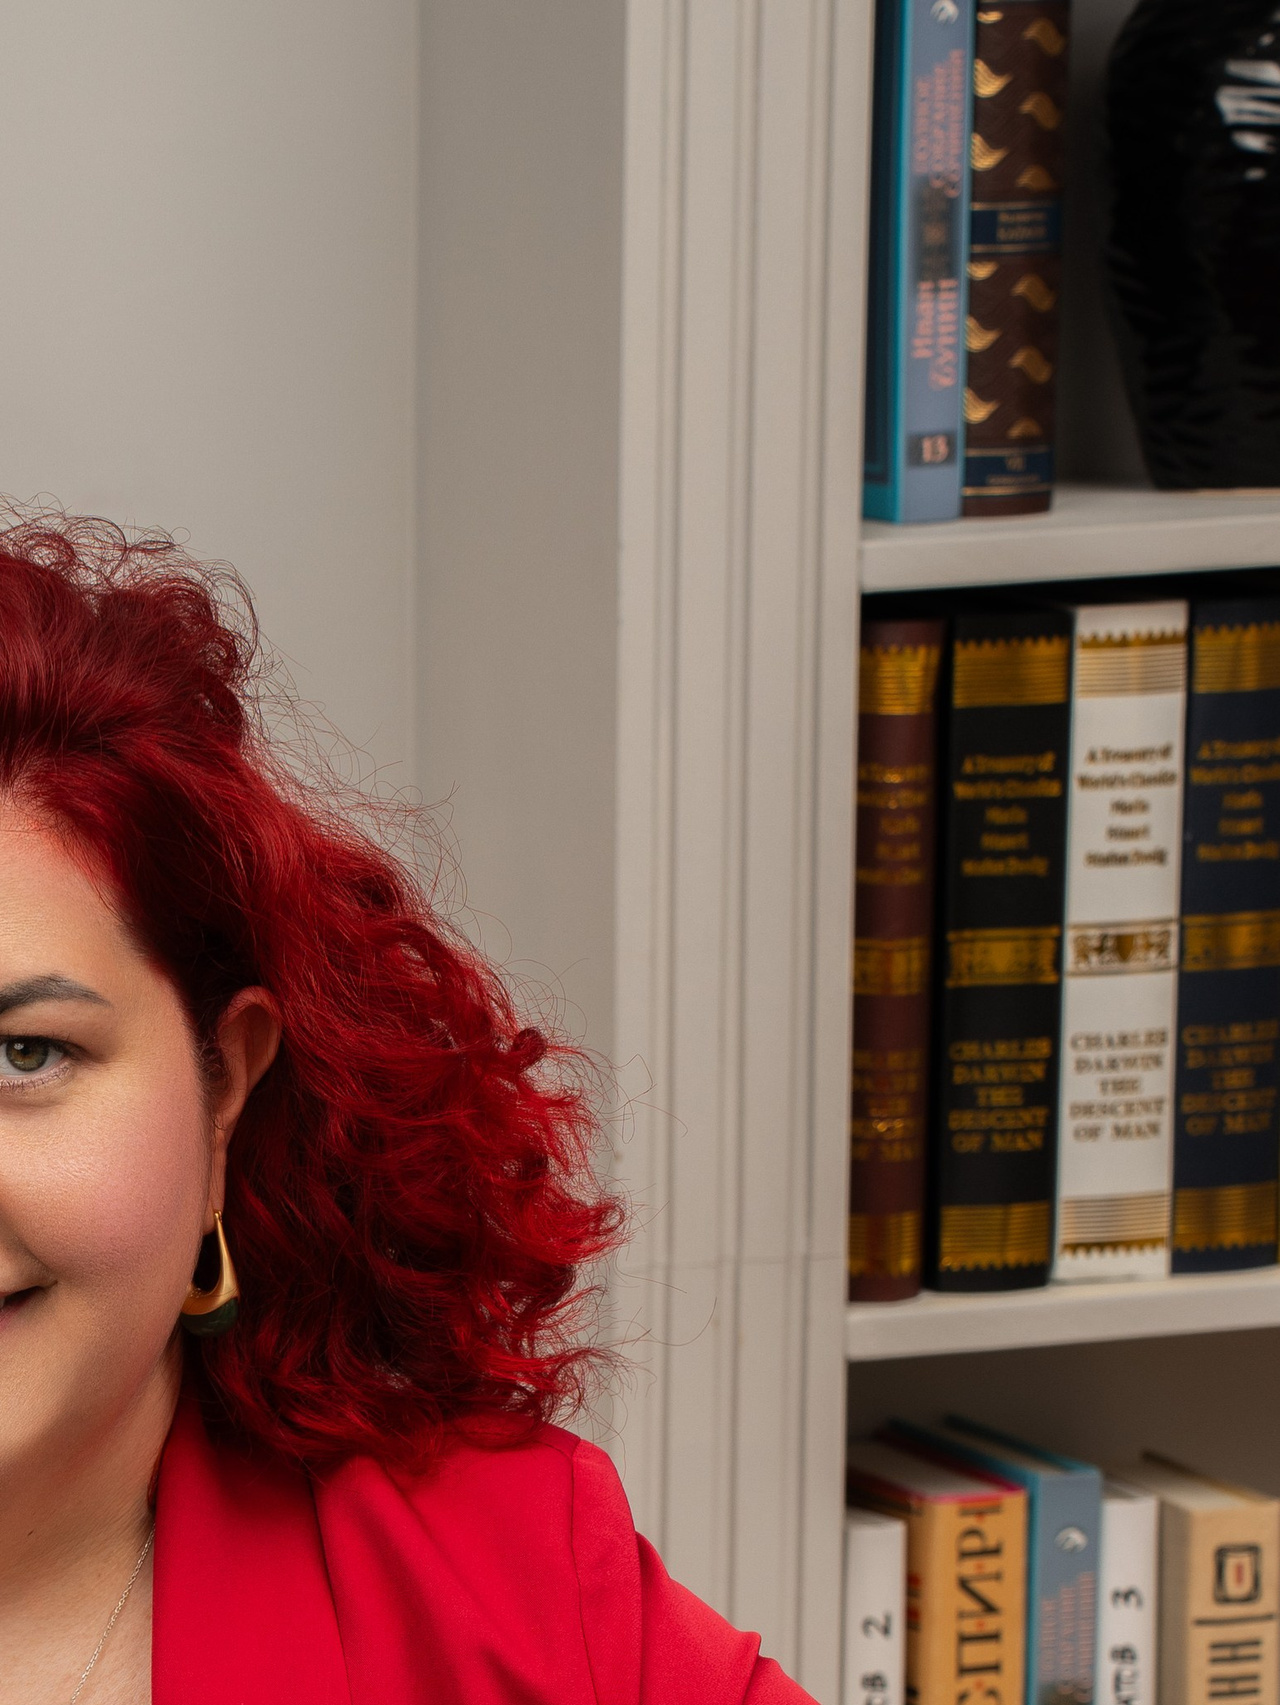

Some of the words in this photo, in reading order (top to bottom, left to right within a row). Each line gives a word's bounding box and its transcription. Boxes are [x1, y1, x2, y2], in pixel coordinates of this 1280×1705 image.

[1085, 748, 1096, 765] A
[1070, 1028, 1168, 1051] CHARLES
[1181, 1020, 1279, 1047] CHARLES
[949, 1036, 1052, 1061] CHARLES
[953, 1060, 1047, 1085] DARWIN
[1074, 1052, 1163, 1075] DARWIN
[977, 1085, 1023, 1107] THE
[1099, 1077, 1140, 1096] THE
[948, 1106, 1050, 1131] DESCENT
[1069, 1096, 1166, 1120] DESCENT
[953, 1132, 983, 1154] OF
[991, 1130, 1044, 1153] MAN
[1073, 1122, 1102, 1142] OF
[1111, 1119, 1160, 1141] MAN
[1111, 1586, 1145, 1608] 3
[862, 1609, 892, 1637] 2
